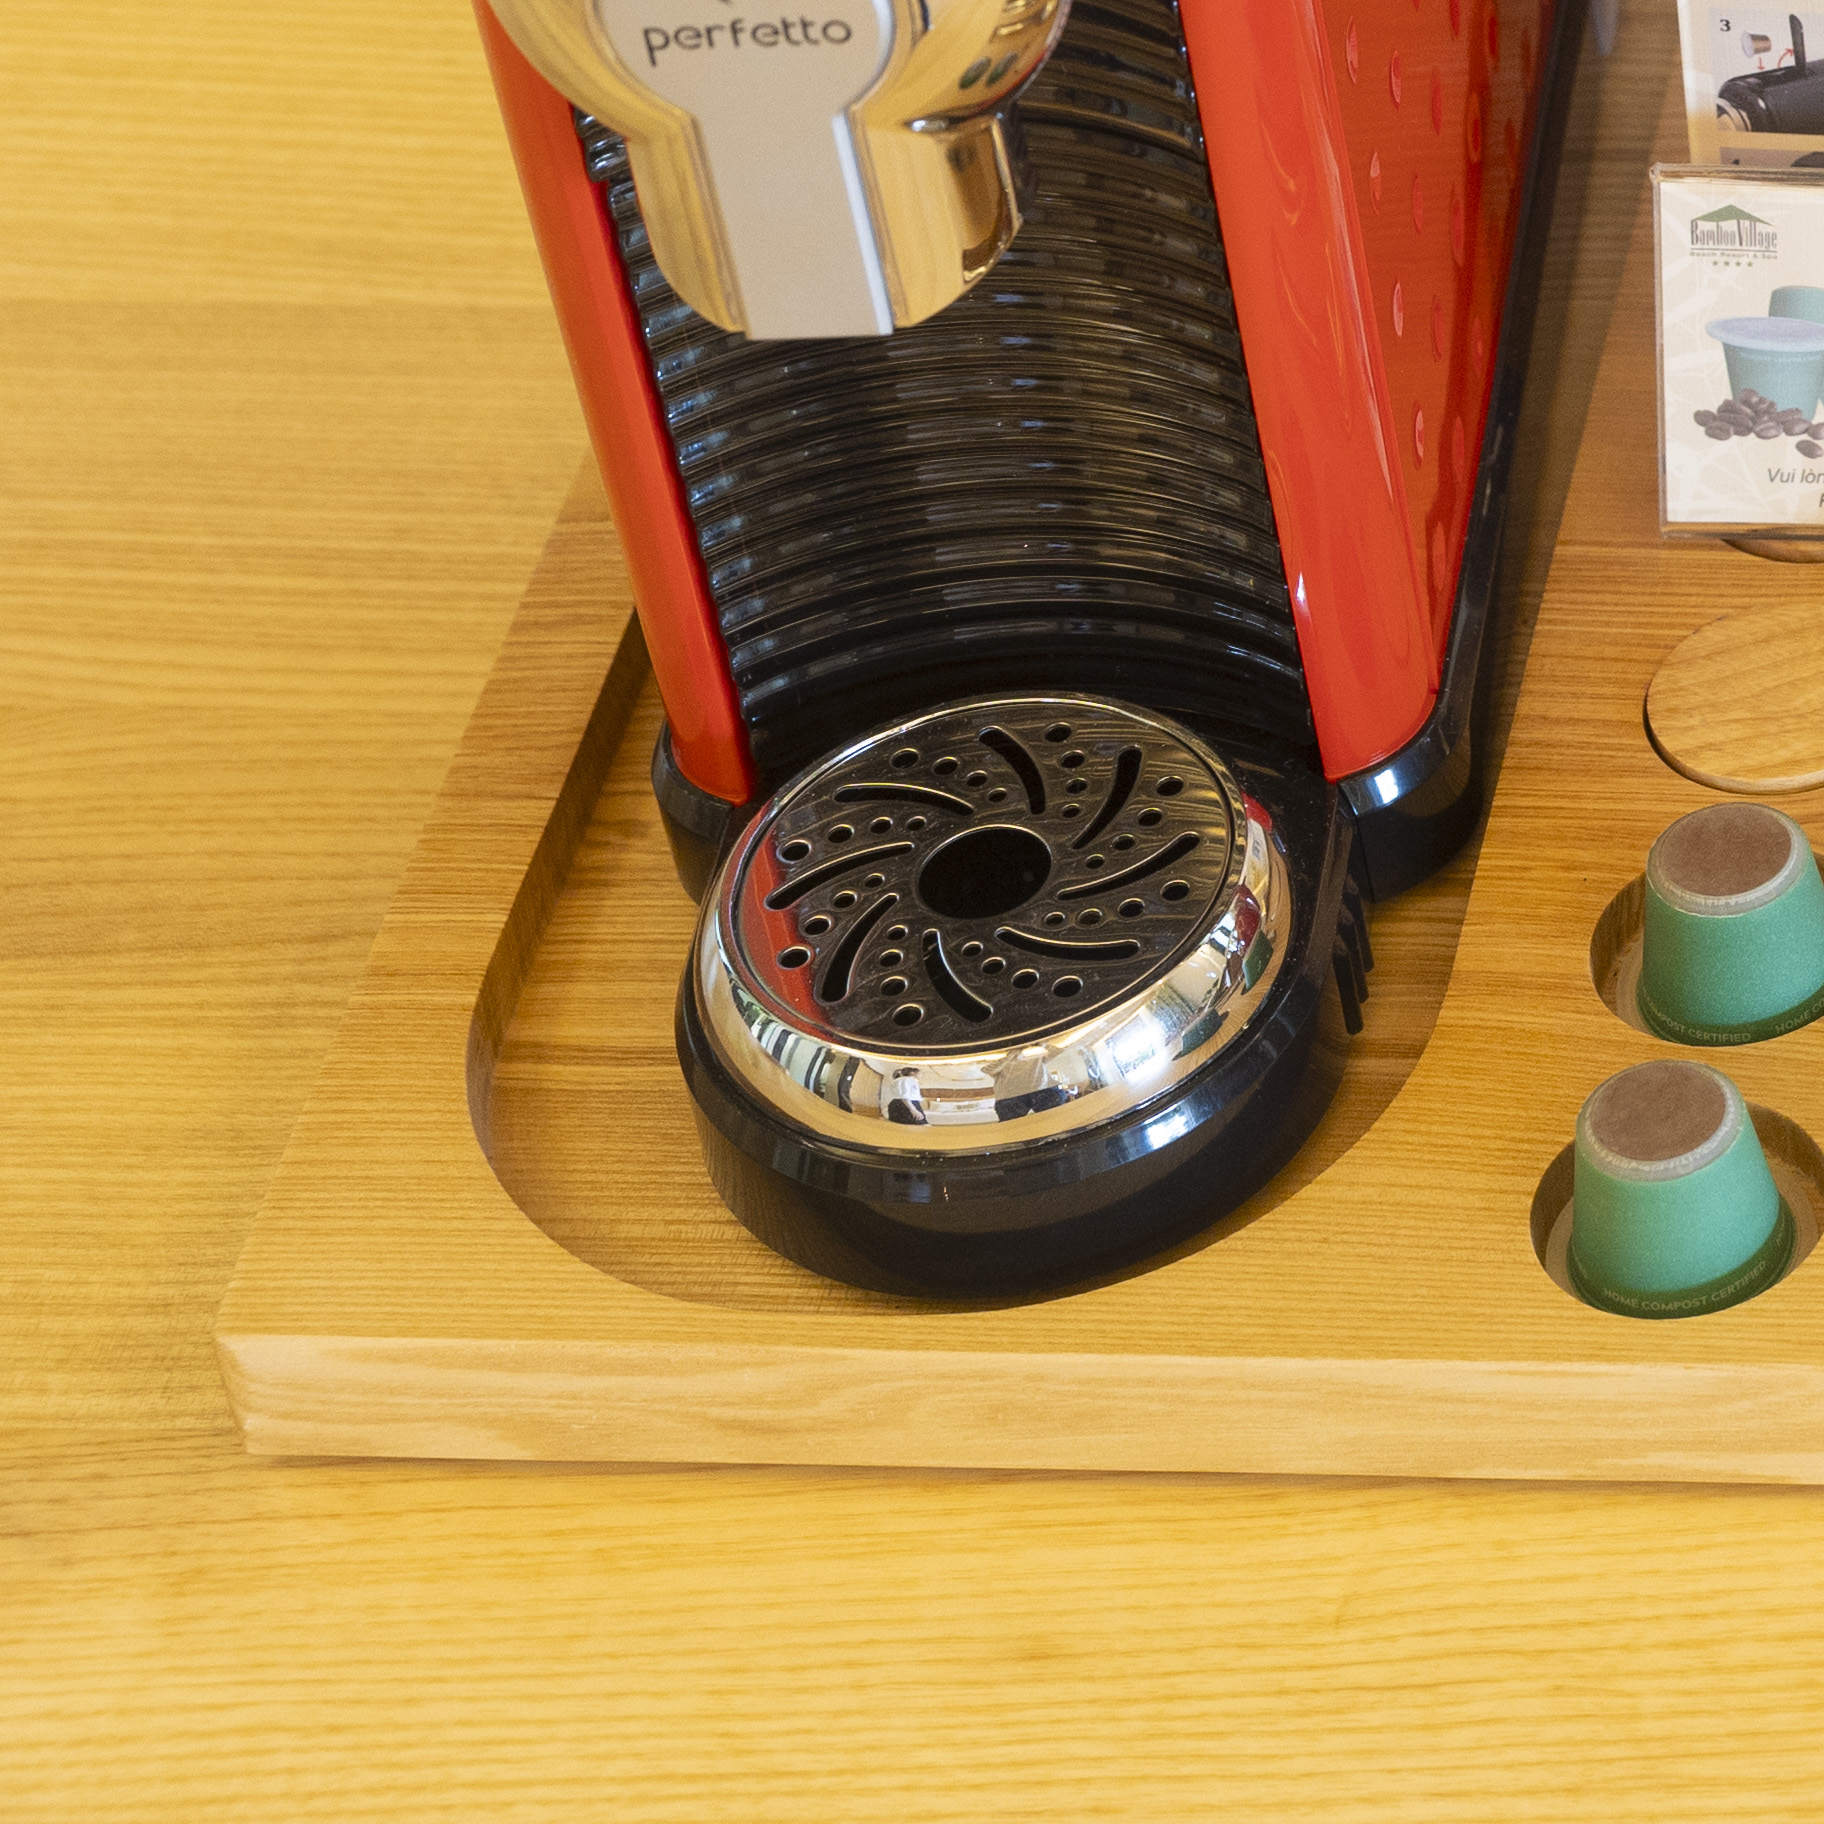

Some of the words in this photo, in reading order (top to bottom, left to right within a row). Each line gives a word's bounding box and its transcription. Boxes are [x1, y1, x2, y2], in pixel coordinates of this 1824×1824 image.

[643, 15, 853, 66] perfetto
[1720, 19, 1730, 32] 3
[1768, 468, 1795, 483] Vui
[1603, 1288, 1639, 1309] HOME
[1642, 1295, 1707, 1311] COMPOST
[1711, 1261, 1766, 1301] CERTIFIED
